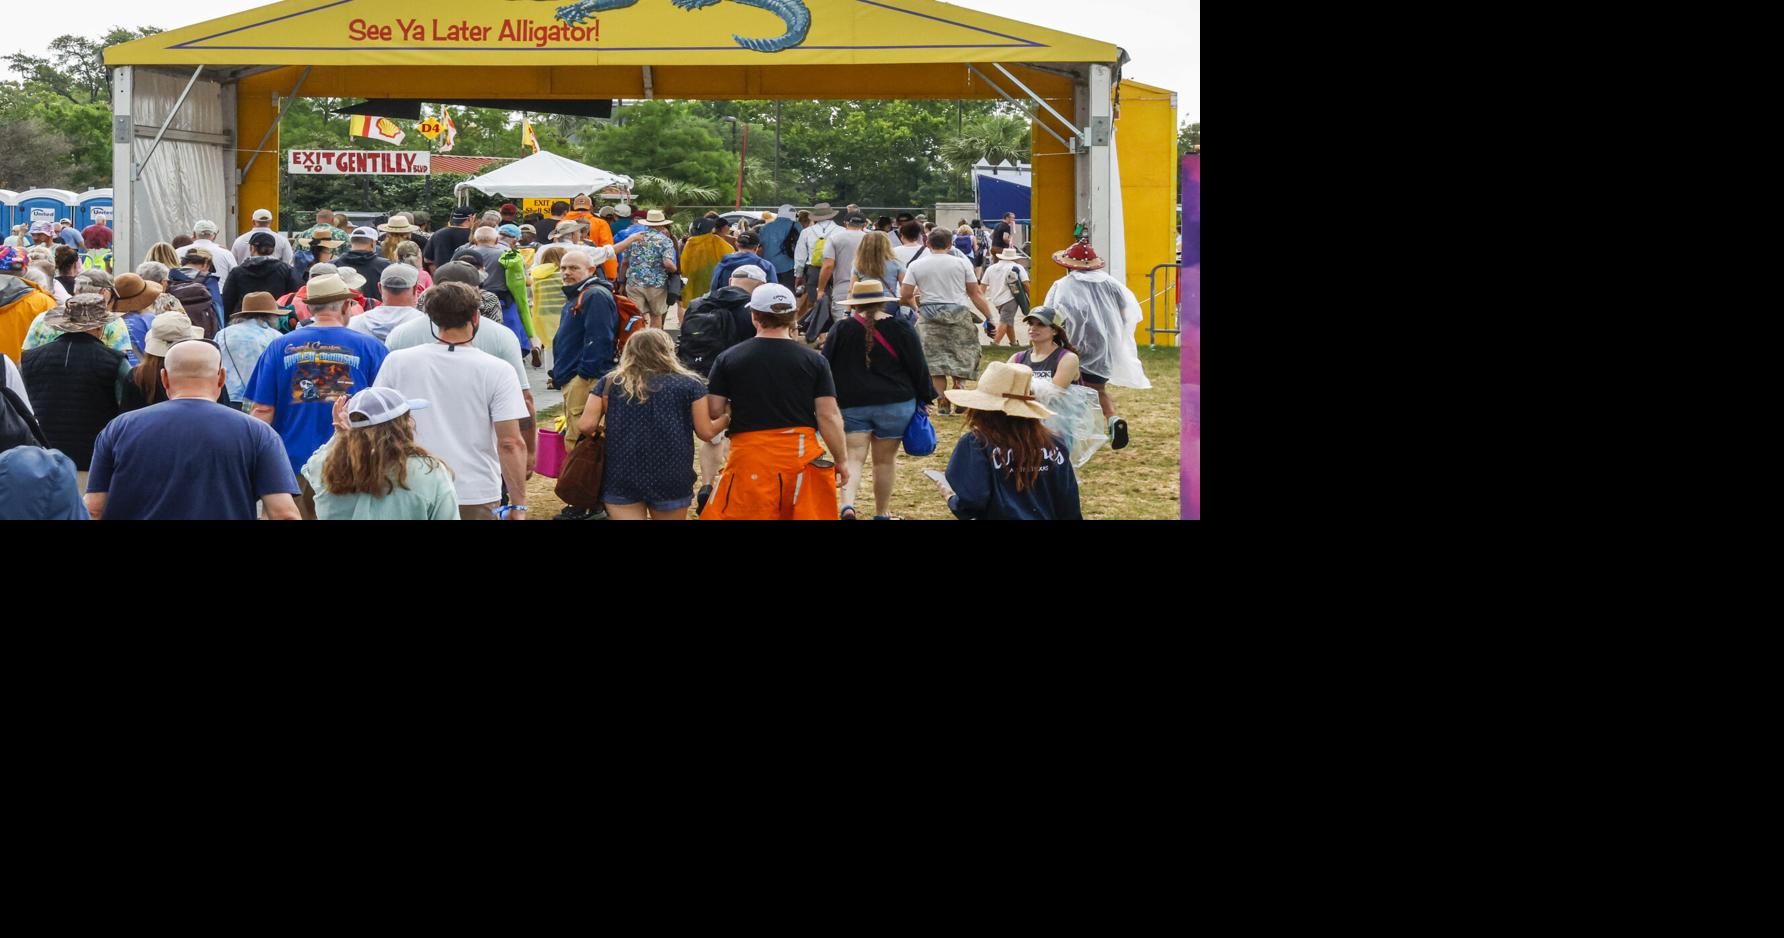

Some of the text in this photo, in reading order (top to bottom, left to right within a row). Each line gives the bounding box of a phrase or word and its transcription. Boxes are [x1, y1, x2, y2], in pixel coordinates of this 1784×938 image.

[349, 18, 600, 47] See Ya Later Alligator!
[421, 123, 440, 133] D4
[292, 151, 428, 173] EXIT GENTILLY BLVD
